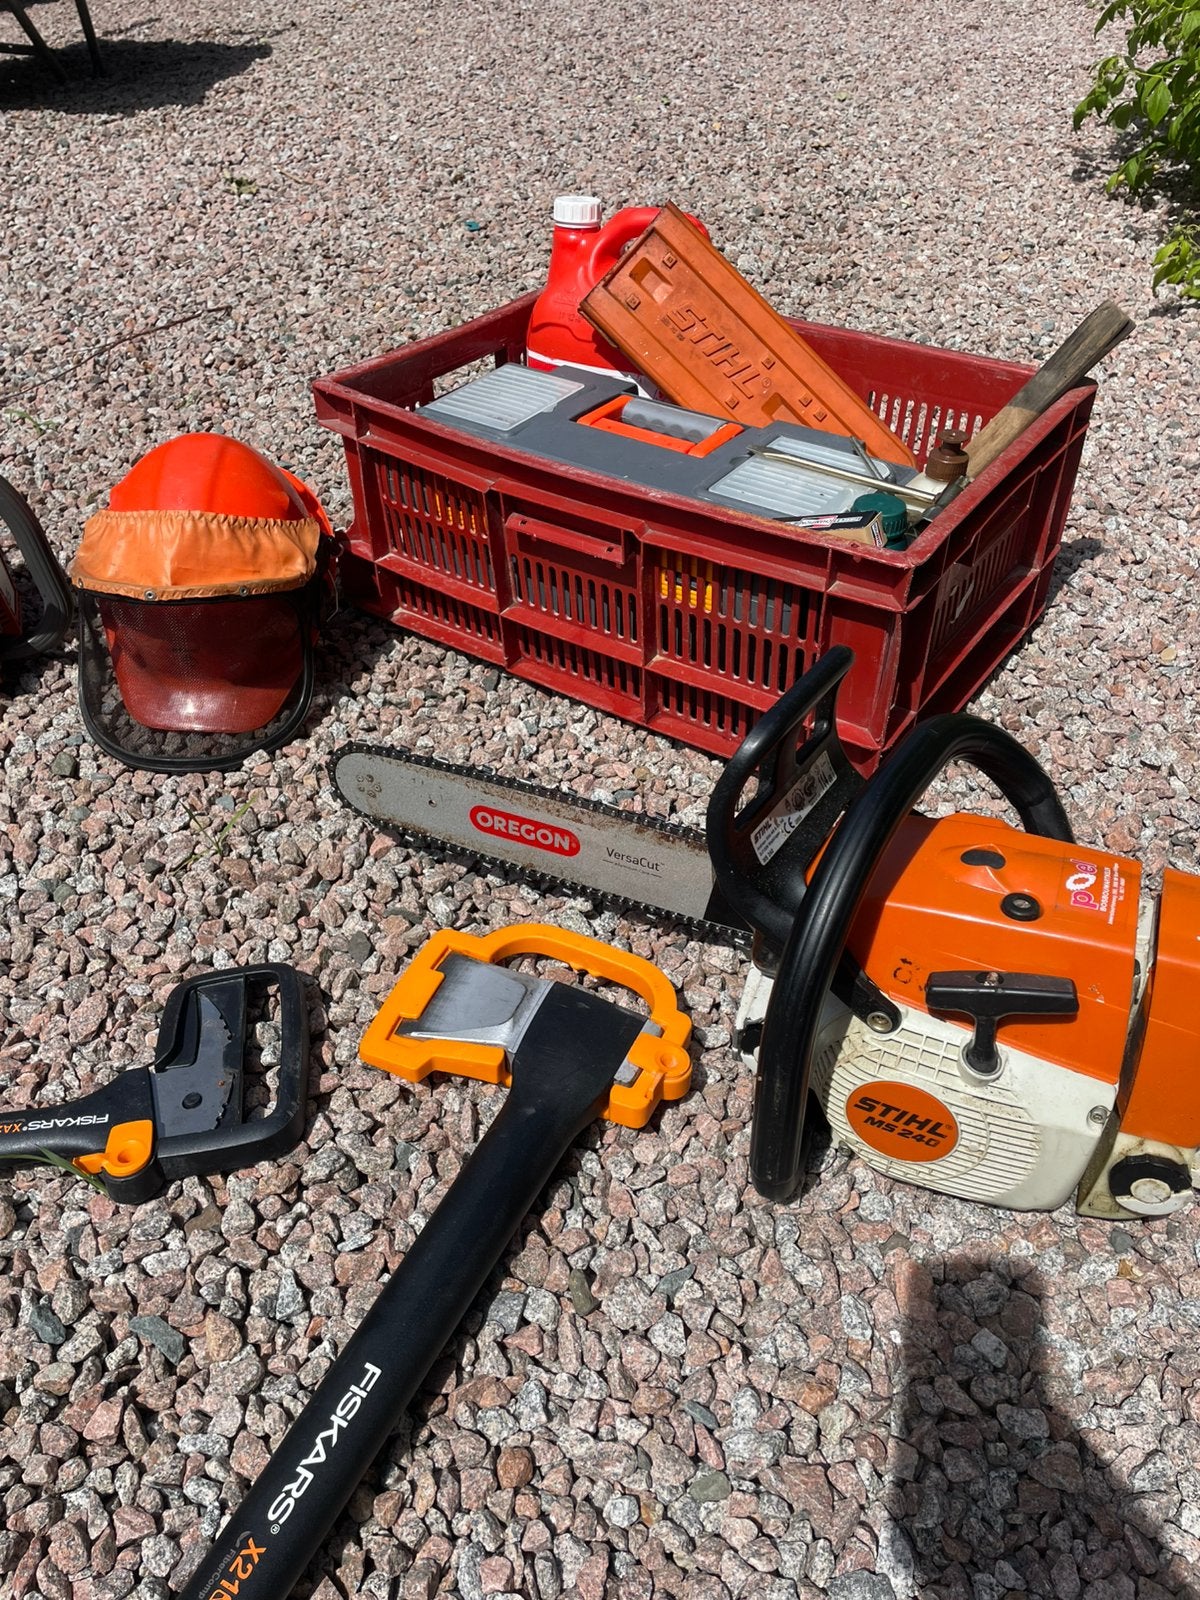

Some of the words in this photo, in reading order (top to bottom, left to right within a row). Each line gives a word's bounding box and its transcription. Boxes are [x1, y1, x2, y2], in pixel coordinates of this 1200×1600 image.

[664, 303, 761, 400] STIHL
[475, 811, 571, 851] OREGON
[605, 847, 661, 872] VersaCut
[28, 1113, 109, 1132] FISKARS
[853, 1096, 948, 1139] STIHL
[863, 1116, 898, 1133] MS
[897, 1128, 941, 1148] 240
